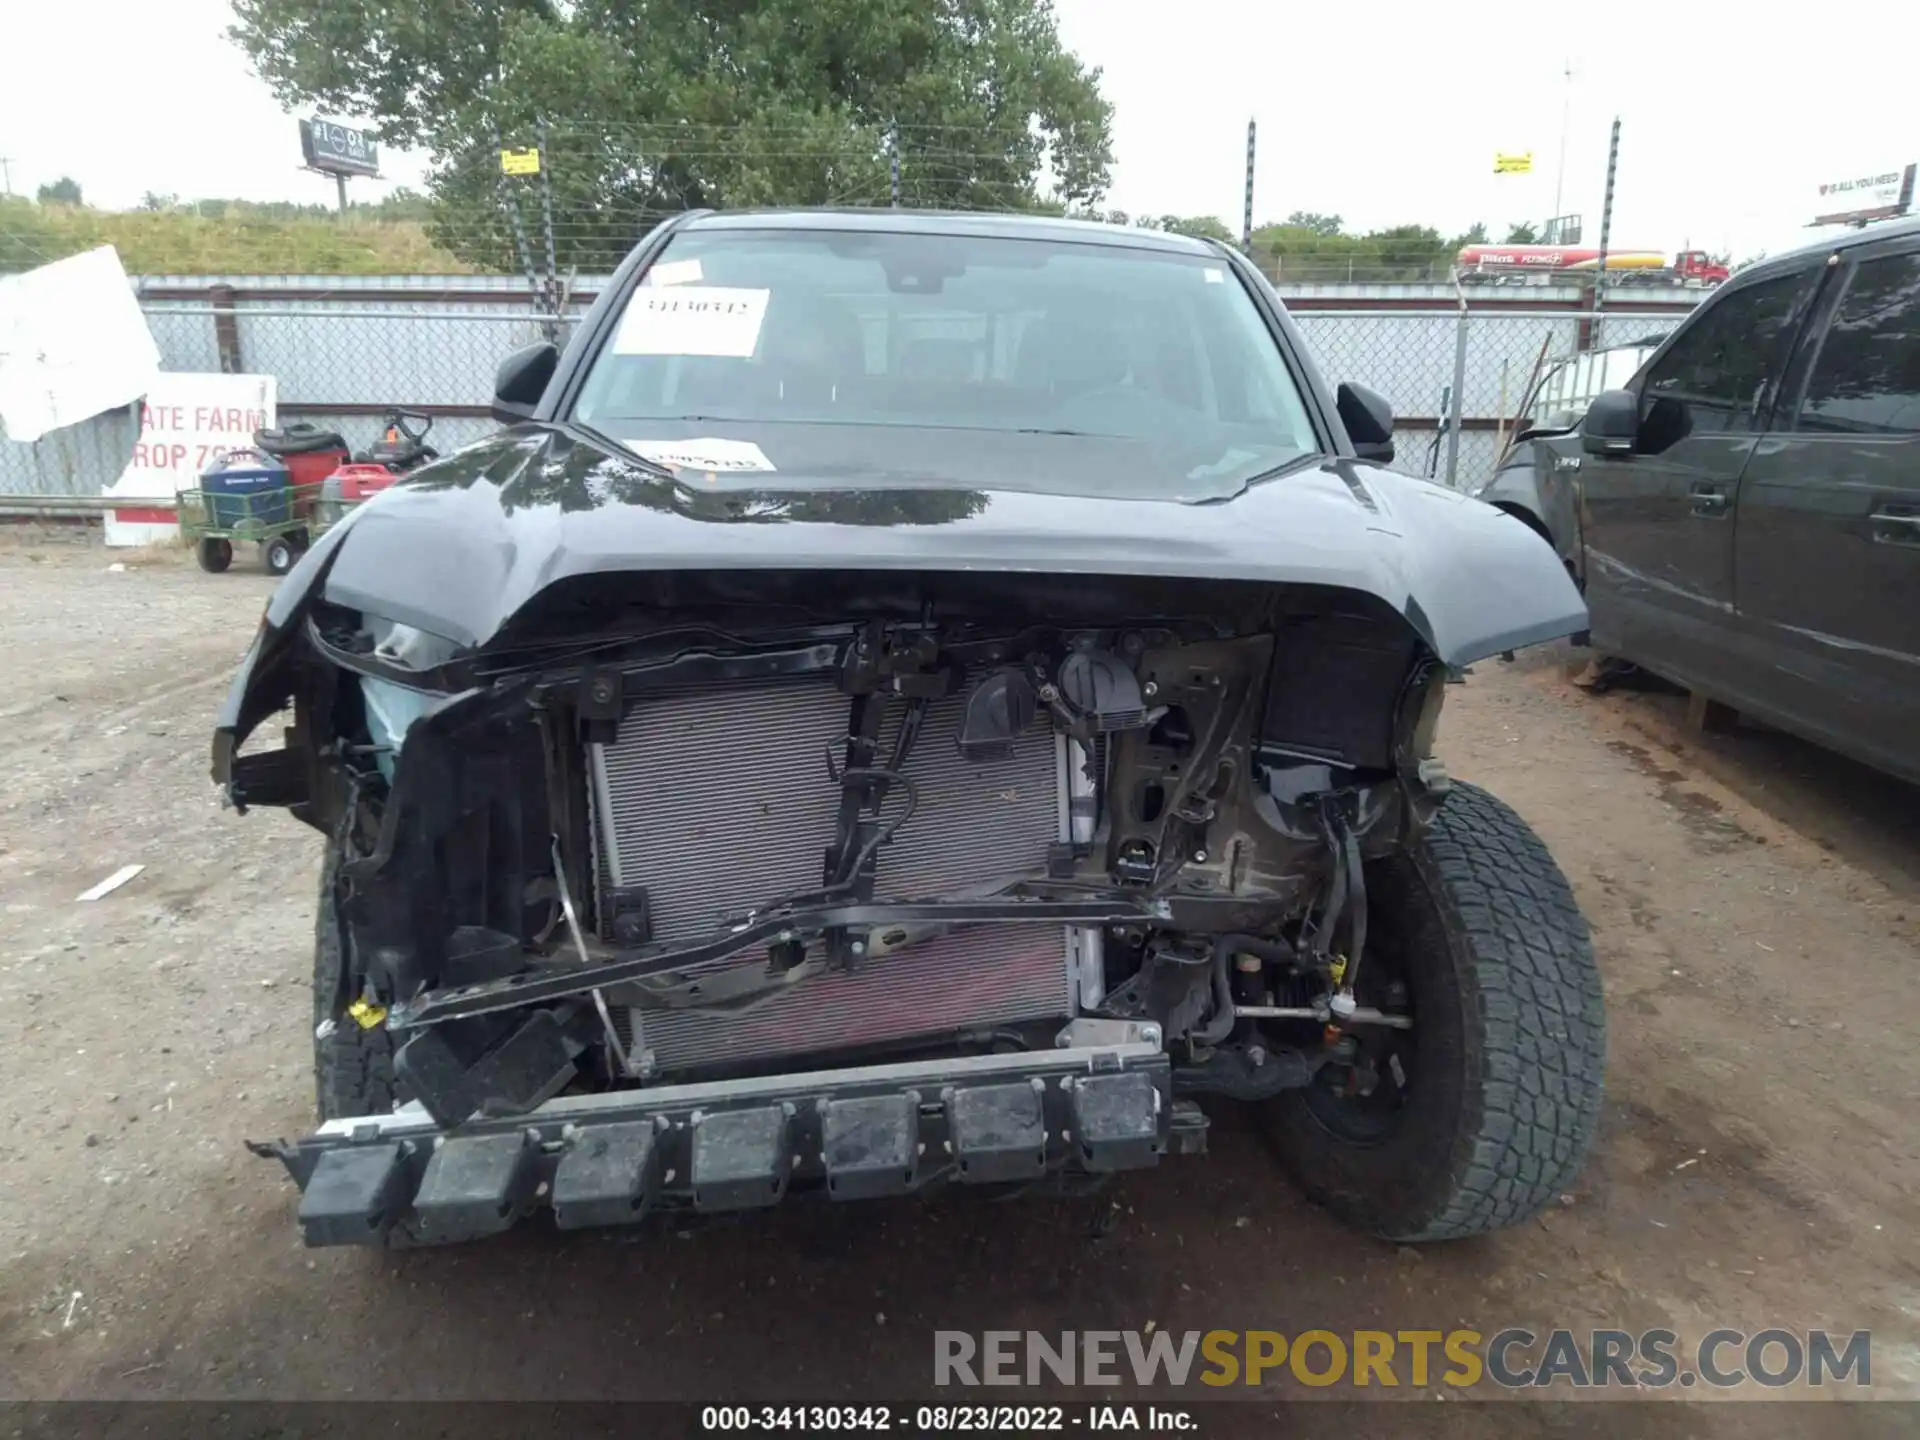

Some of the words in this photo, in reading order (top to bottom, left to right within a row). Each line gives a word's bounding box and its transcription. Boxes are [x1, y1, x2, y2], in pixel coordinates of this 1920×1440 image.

[1838, 180, 1854, 191] ALL
[1855, 175, 1873, 188] YOU
[195, 406, 267, 432] FARM
